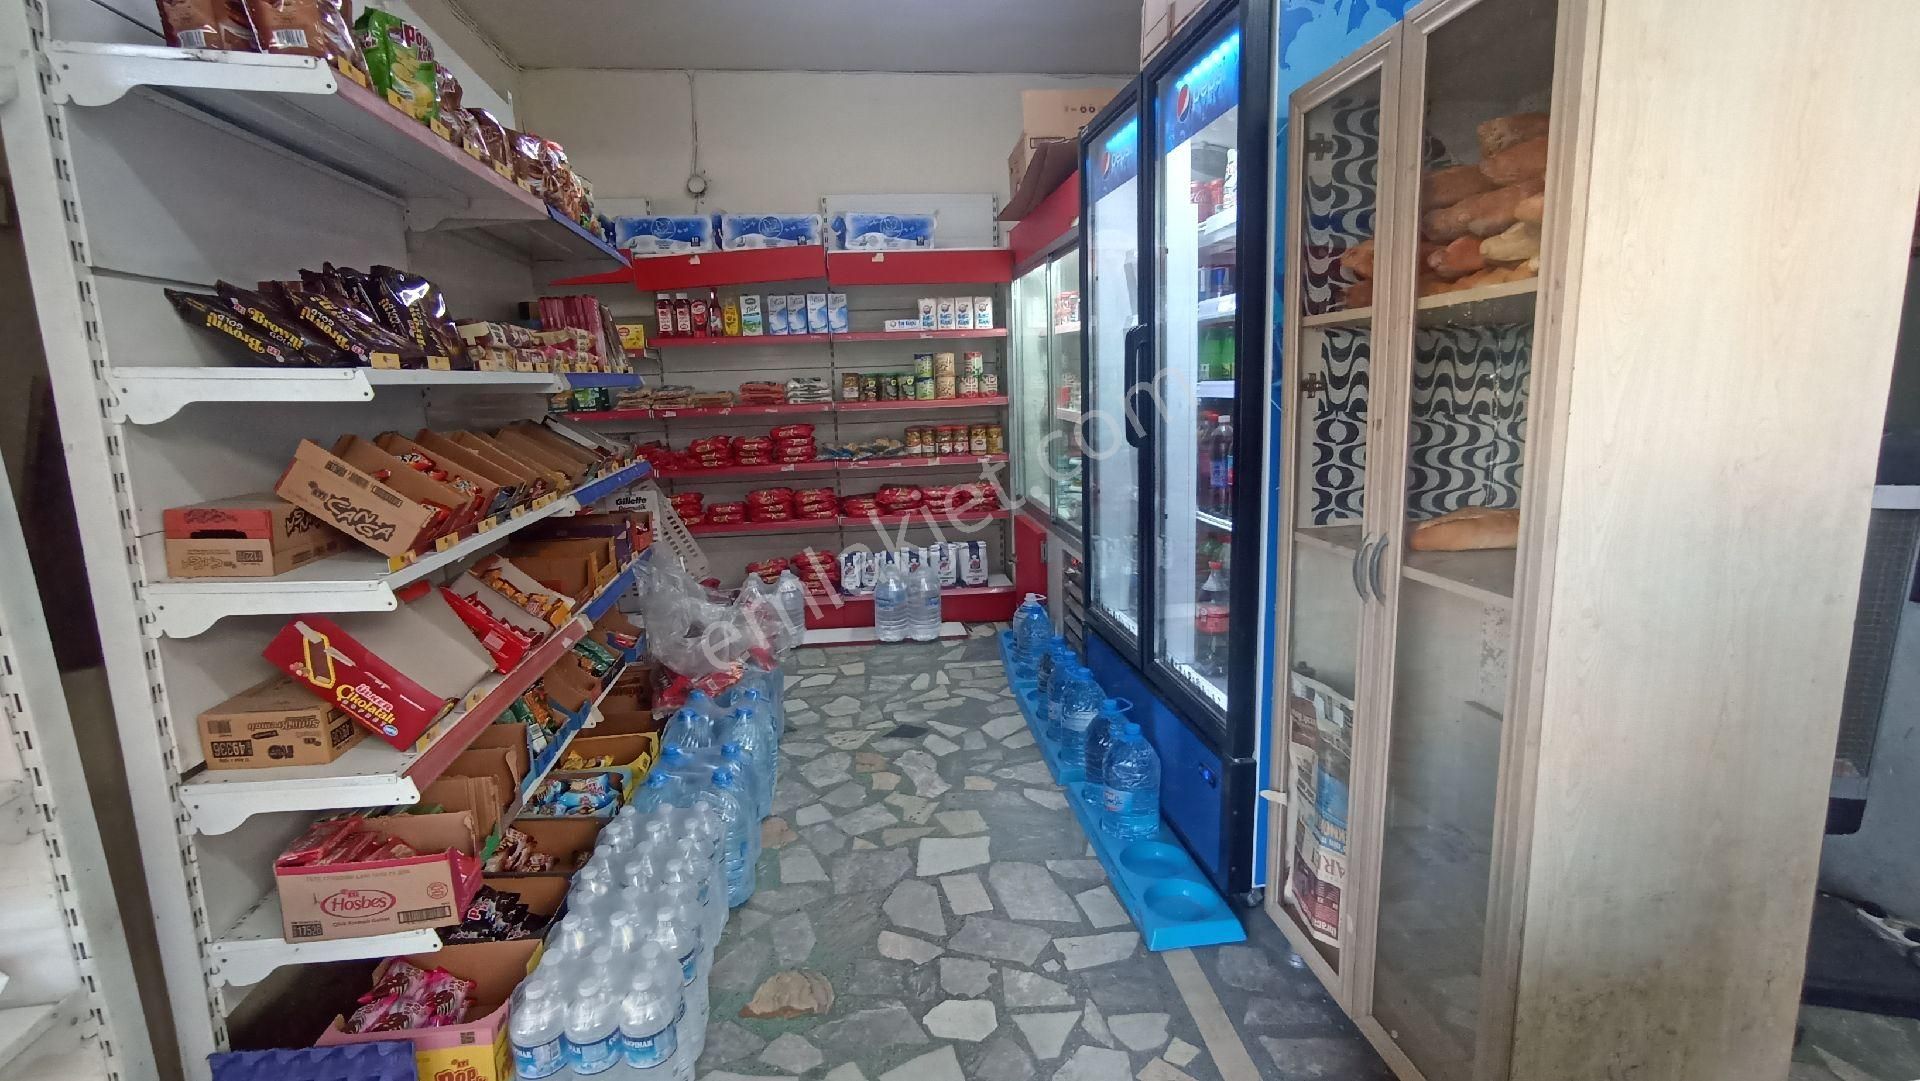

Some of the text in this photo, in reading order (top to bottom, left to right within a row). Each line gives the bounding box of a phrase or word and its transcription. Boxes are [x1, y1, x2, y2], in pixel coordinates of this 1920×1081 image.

[206, 311, 265, 354] Browni
[218, 314, 244, 330] GOLD
[616, 497, 647, 505] Gillette
[336, 684, 396, 724] Çikolatalı
